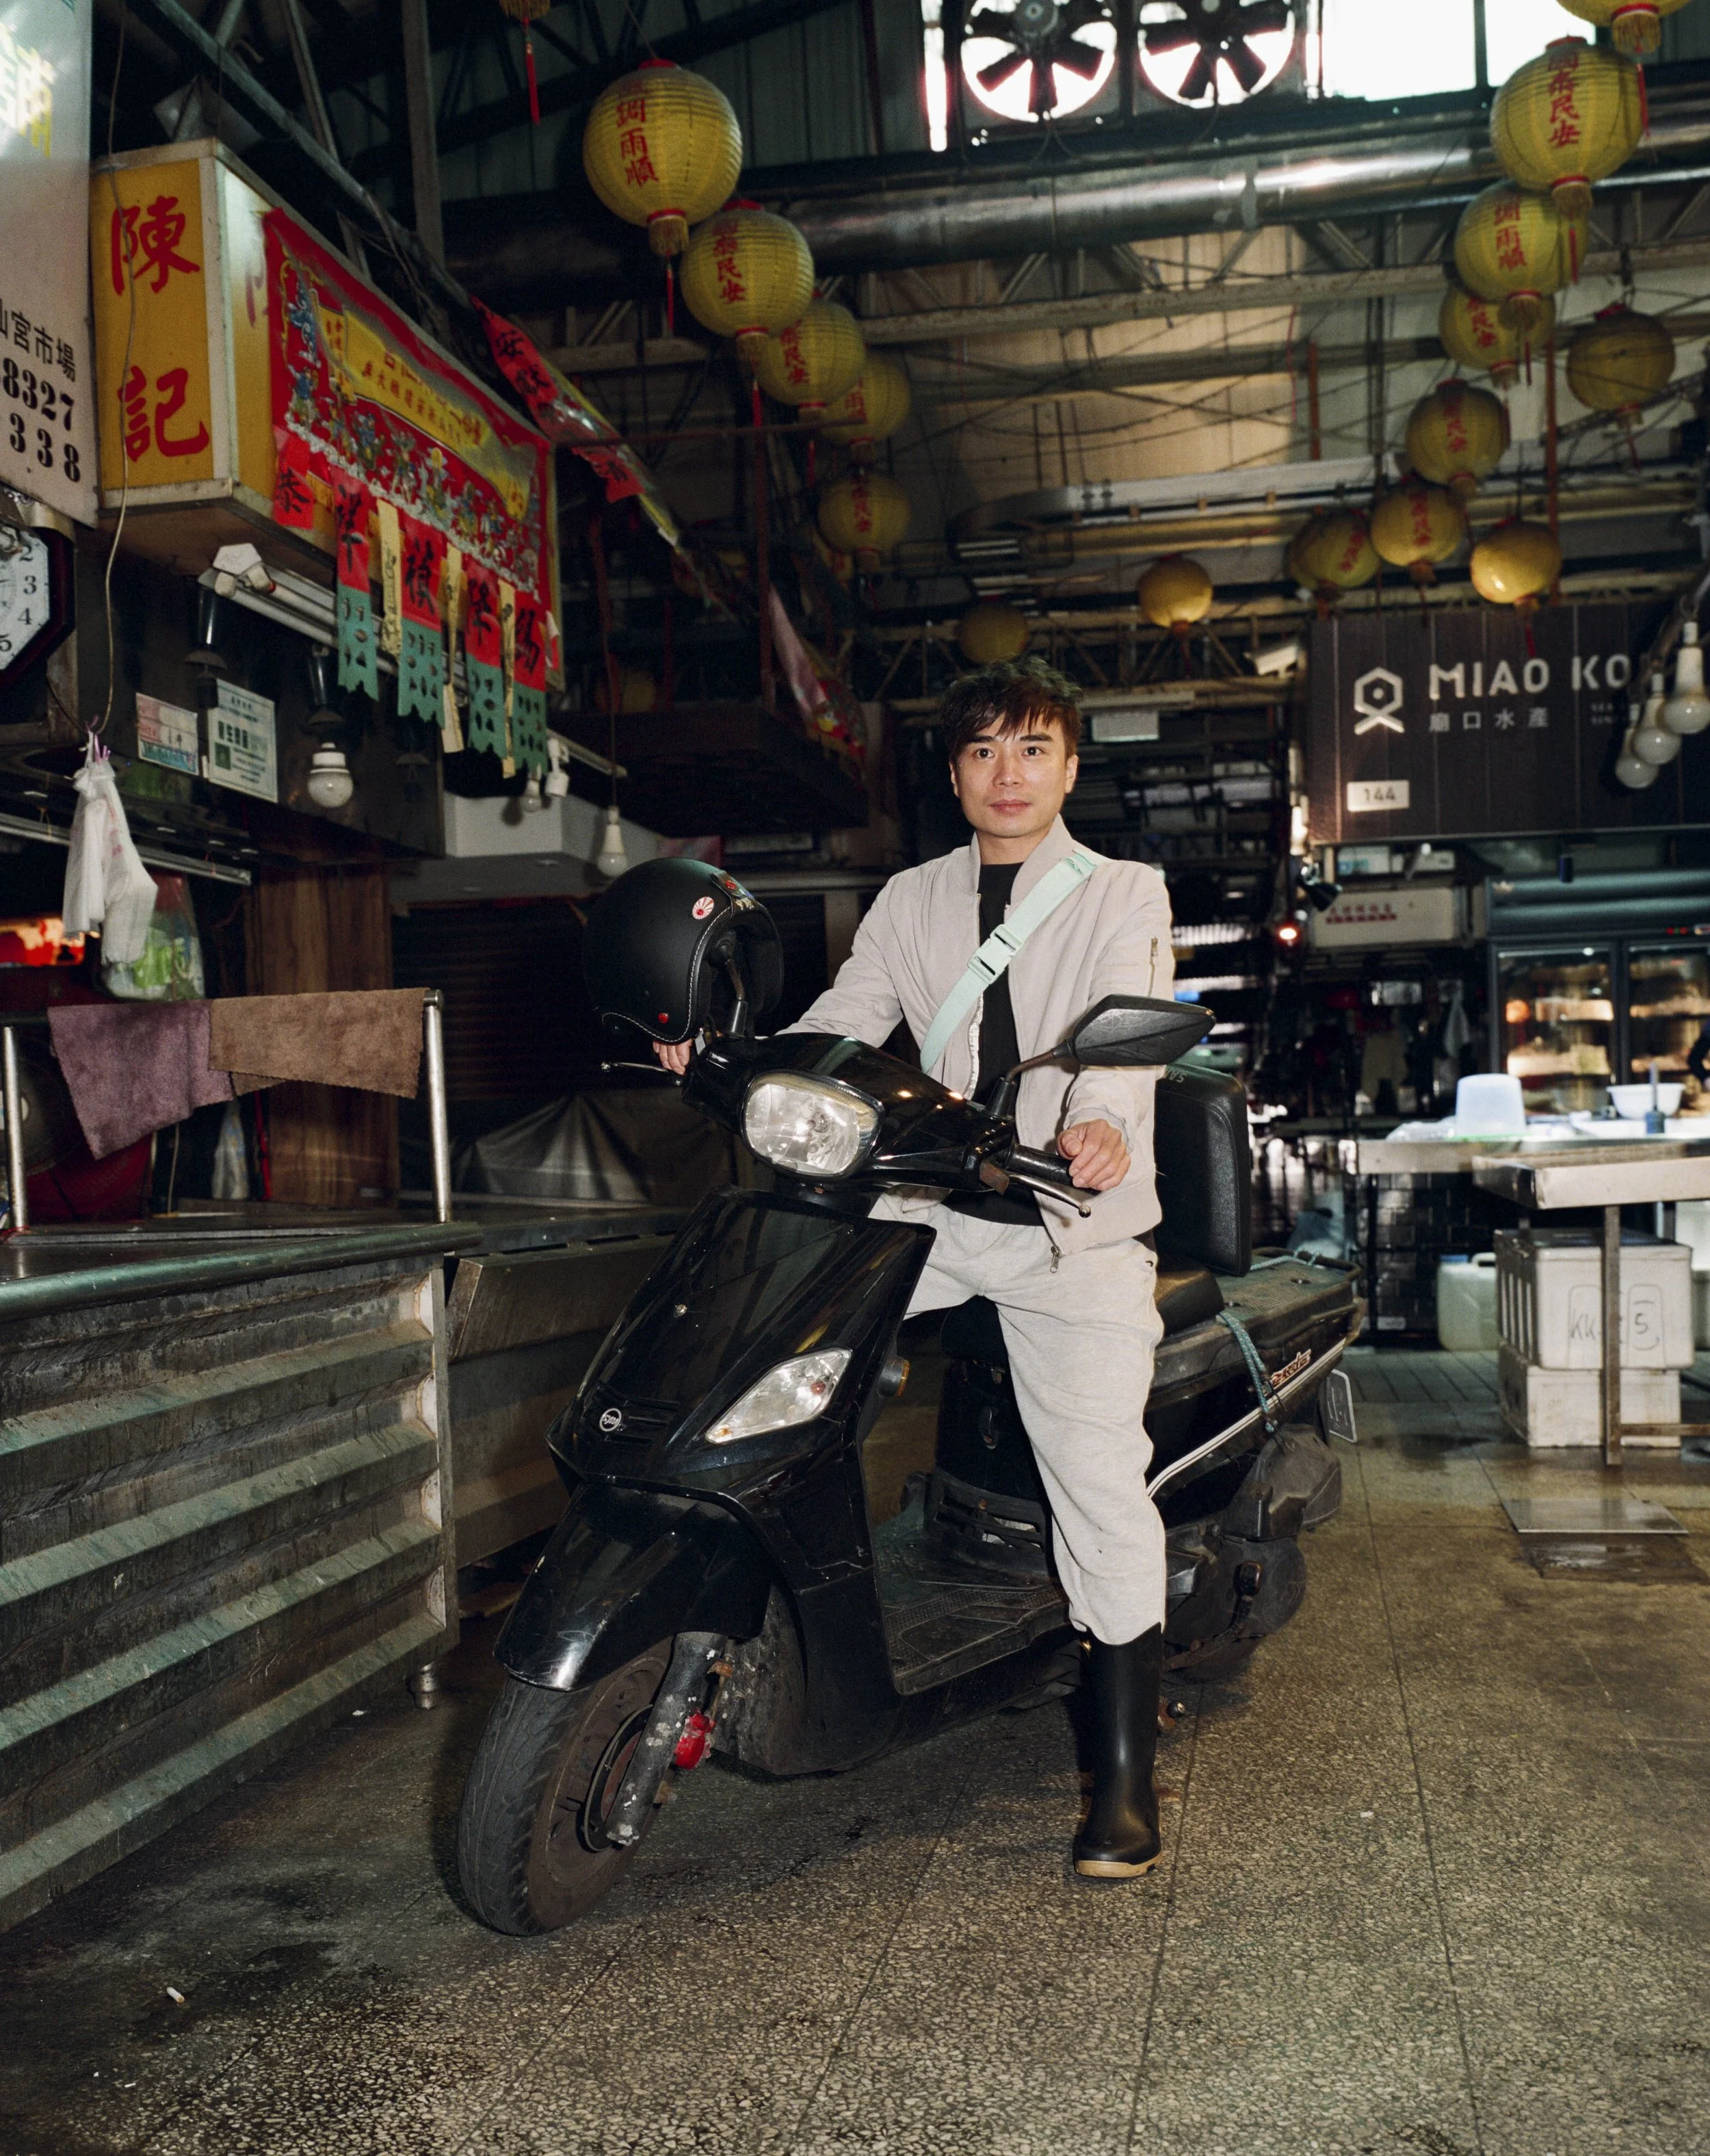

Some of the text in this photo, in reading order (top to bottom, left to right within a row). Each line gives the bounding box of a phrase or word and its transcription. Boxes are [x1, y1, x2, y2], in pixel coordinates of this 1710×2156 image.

[107, 196, 209, 462] 陳記
[3, 357, 75, 432] 8327
[23, 575, 37, 594] 3
[18, 607, 32, 625] 4
[1430, 653, 1631, 700] MIAO KO
[1365, 787, 1396, 802] 144
